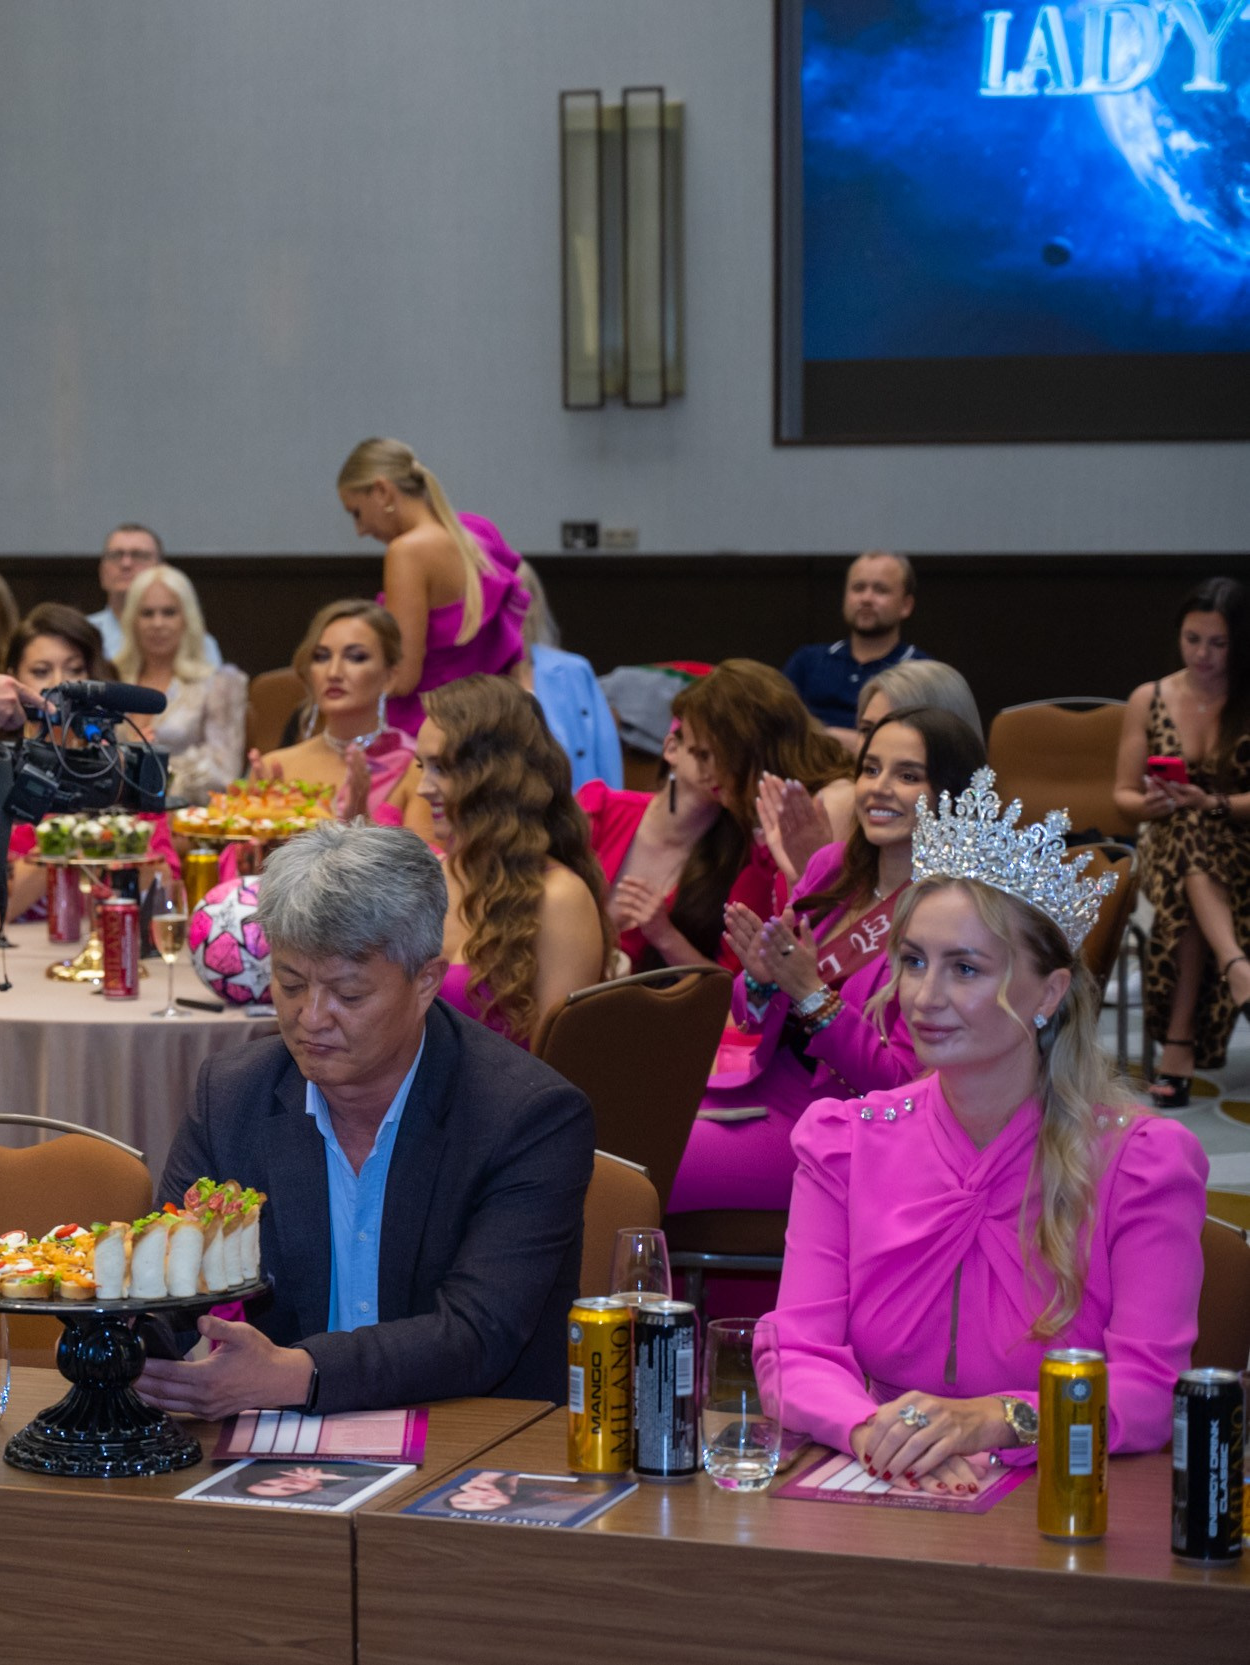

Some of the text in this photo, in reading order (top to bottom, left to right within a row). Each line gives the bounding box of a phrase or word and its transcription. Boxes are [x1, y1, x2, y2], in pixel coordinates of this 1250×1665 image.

[980, 0, 1244, 96] LADY
[591, 1351, 603, 1435] MANGO
[610, 1325, 631, 1455] MILANO
[1208, 1418, 1220, 1539] ENERGY DRINK
[1219, 1442, 1229, 1515] CLASSIC
